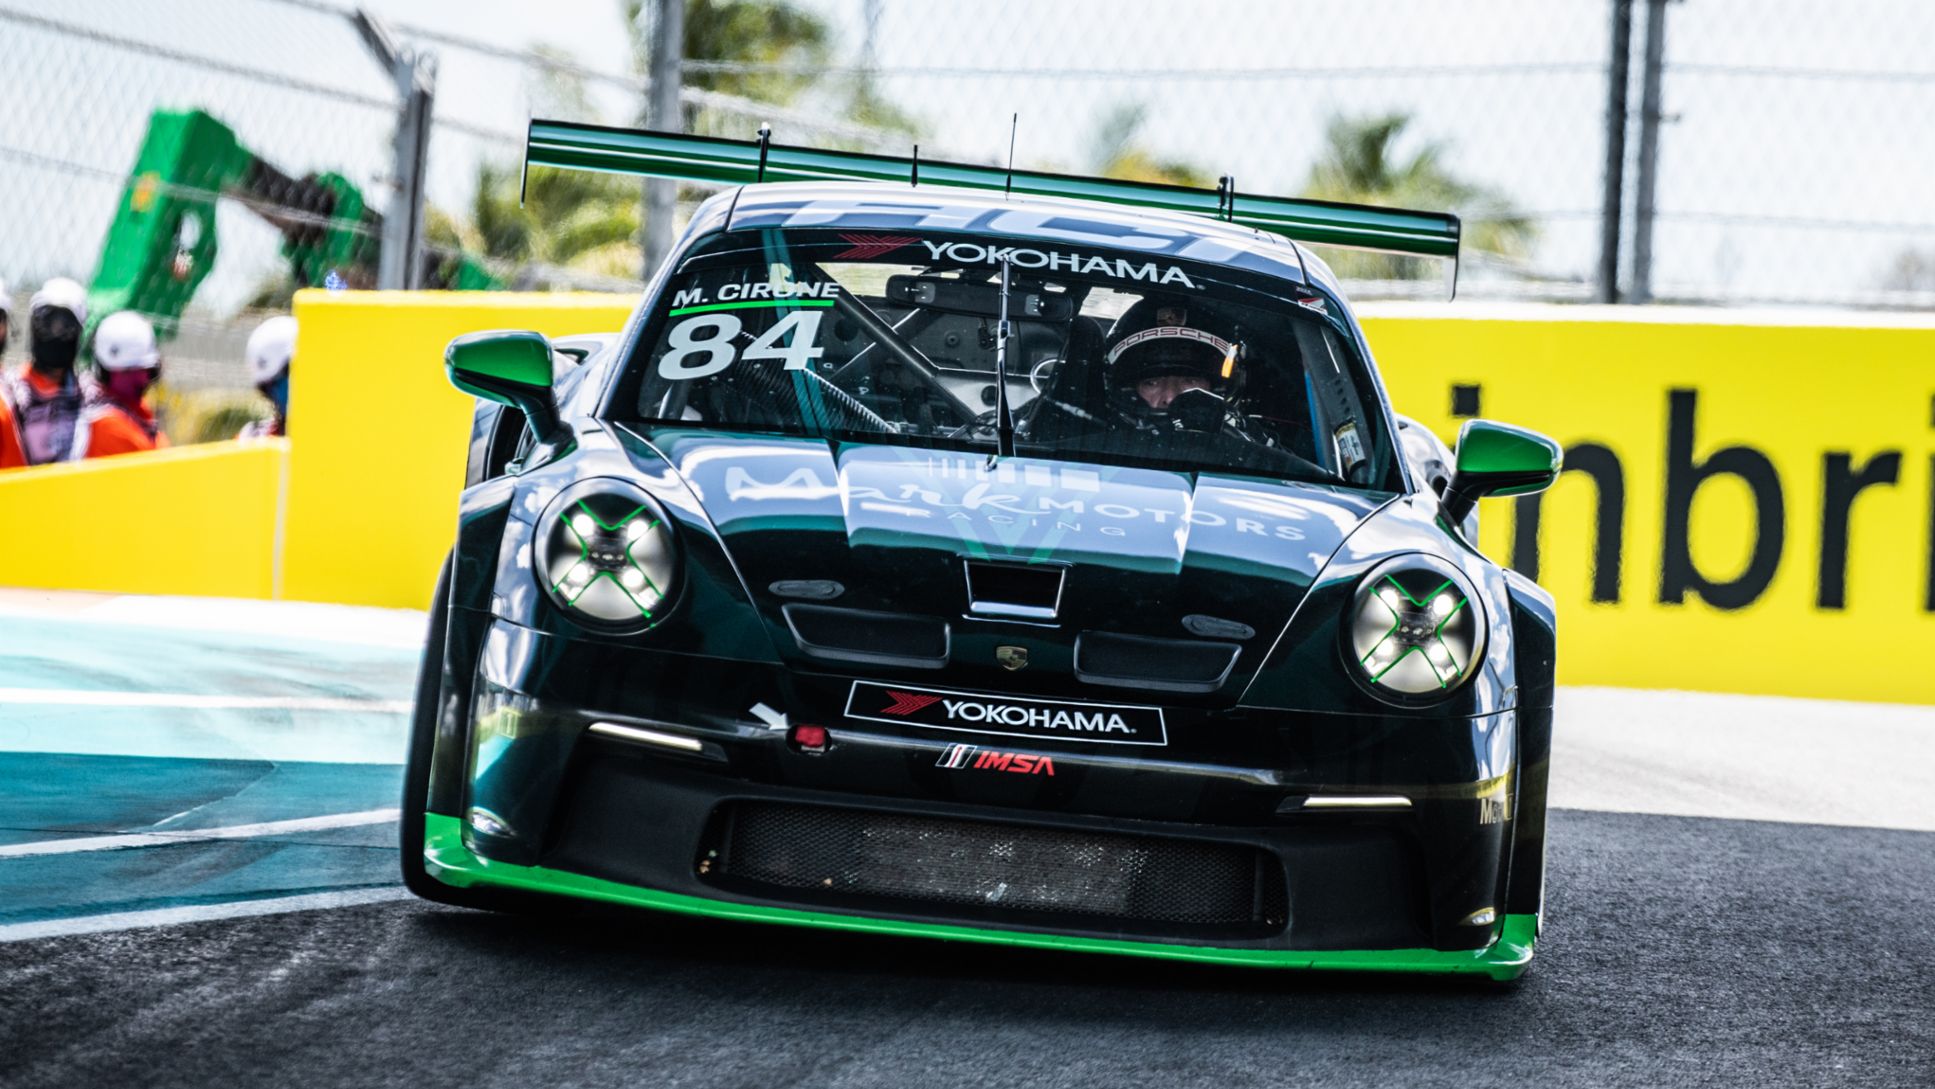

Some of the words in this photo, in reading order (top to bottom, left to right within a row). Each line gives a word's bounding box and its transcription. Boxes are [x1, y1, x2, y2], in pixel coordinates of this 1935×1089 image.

[922, 240, 1196, 288] YOKOHAMA
[672, 288, 708, 307] M.
[717, 282, 840, 300] CIRONE
[658, 311, 824, 380] 84
[1113, 326, 1230, 354] PORSCHE
[1450, 384, 1935, 611] nbr
[1039, 496, 1306, 541] MOTORS
[944, 699, 1130, 734] YOKOHAMA
[972, 751, 1055, 776] IMSA
